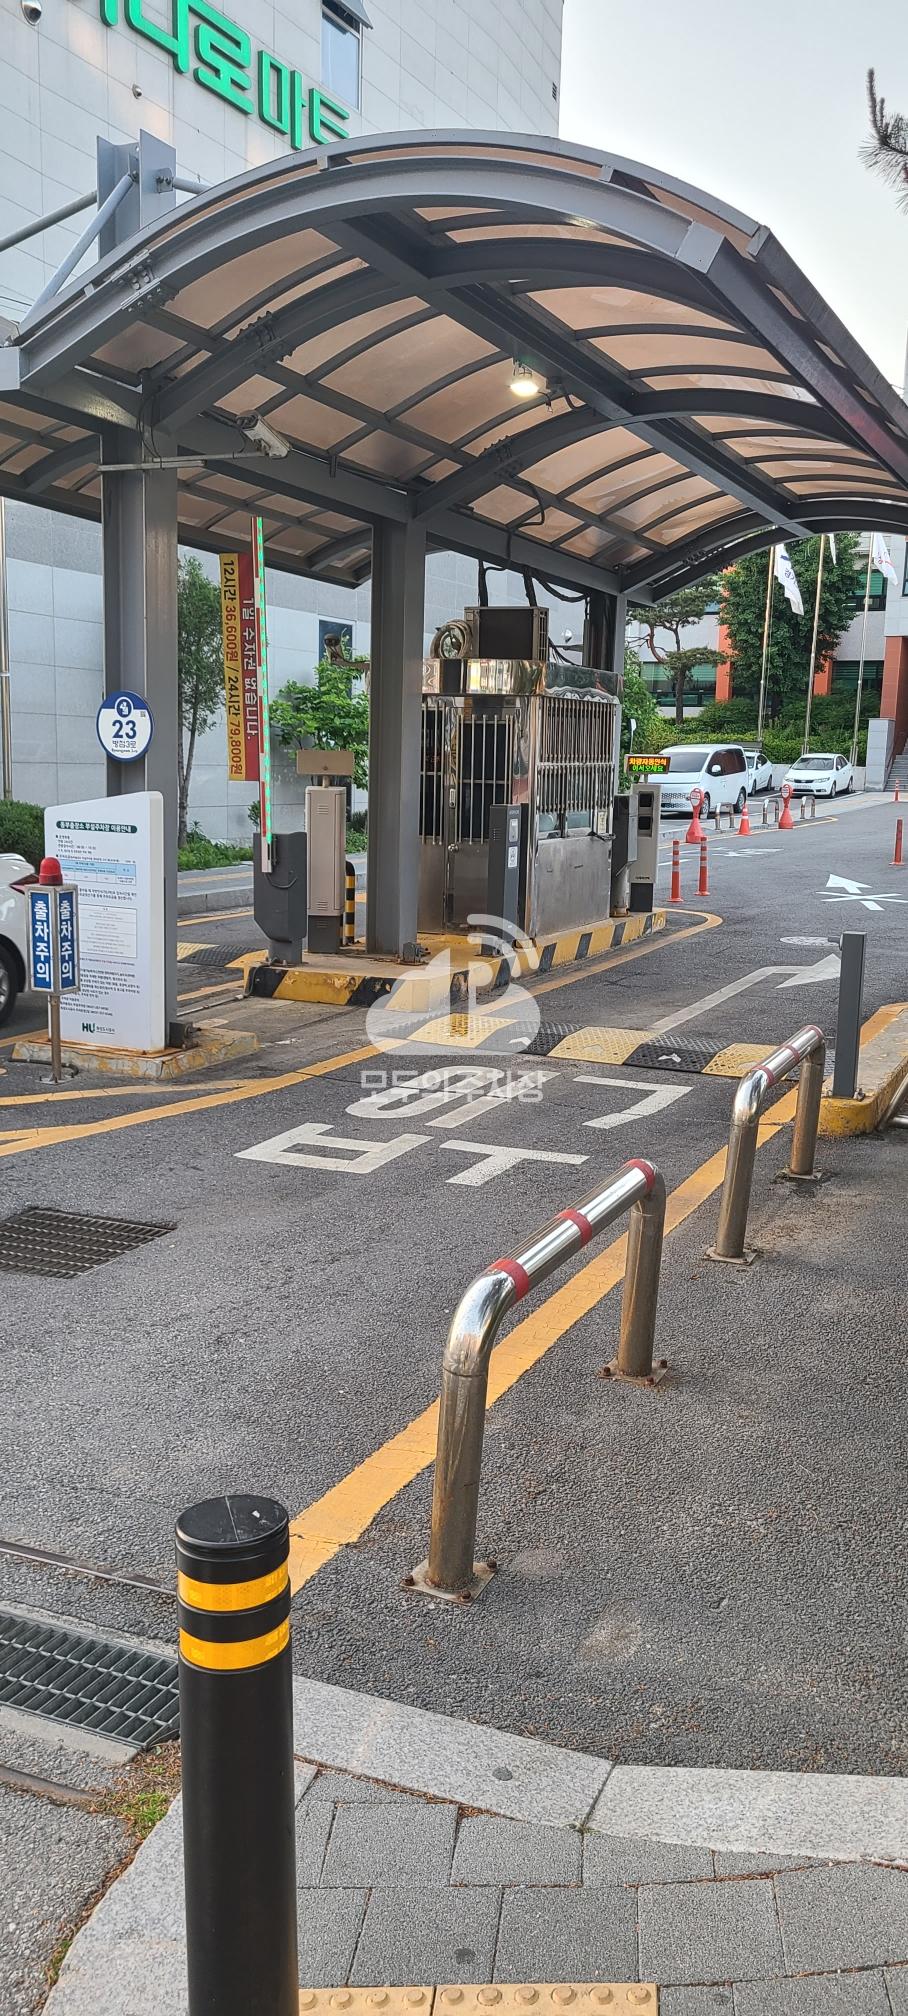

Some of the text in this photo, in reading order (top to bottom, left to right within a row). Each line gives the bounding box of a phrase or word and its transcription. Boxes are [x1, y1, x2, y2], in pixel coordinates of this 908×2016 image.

[100, 0, 350, 151] 나로마트
[223, 560, 236, 602] 12시간
[225, 605, 238, 662] 36,600원
[228, 676, 240, 717] 24시간
[112, 719, 136, 739] 23
[229, 720, 242, 775] 79,800원
[629, 757, 667, 765] 차량자동인식
[111, 824, 132, 833] 이용안내
[33, 900, 50, 982] 출차주의
[59, 899, 73, 980] 출차주의
[82, 1022, 96, 1033] HU
[234, 1066, 694, 1187] 입구
